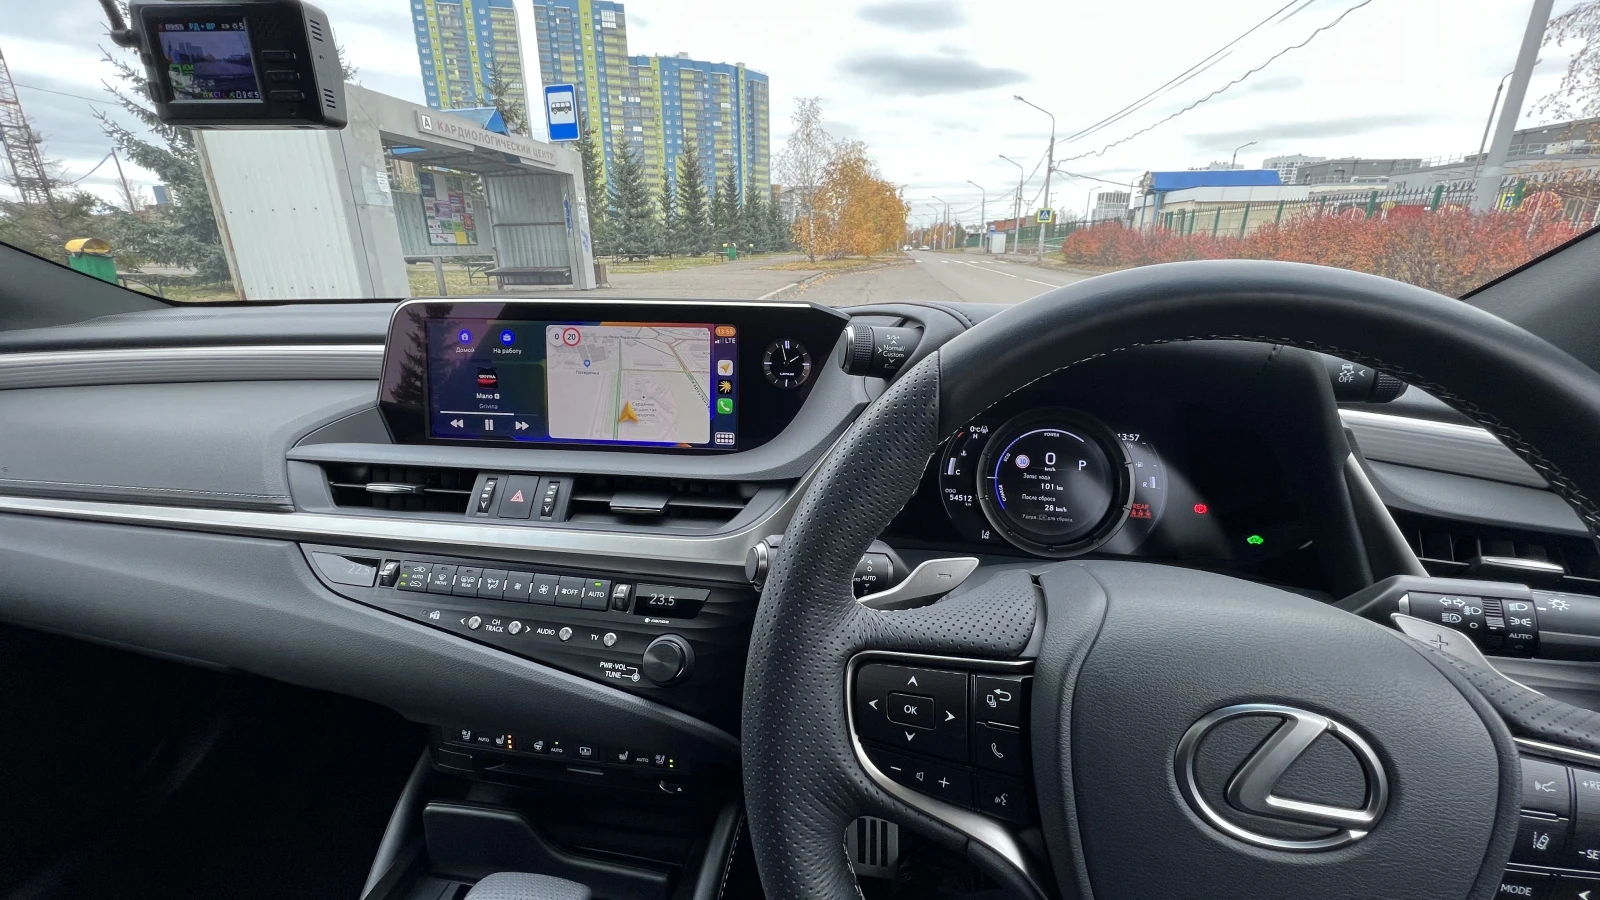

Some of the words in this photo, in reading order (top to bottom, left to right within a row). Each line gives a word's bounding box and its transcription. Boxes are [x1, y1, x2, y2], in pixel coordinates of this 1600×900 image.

[437, 120, 532, 155] КАРДИОЛОГИЧЕСКИЙ
[532, 147, 554, 161] ЦЕНТР
[567, 333, 577, 341] 20
[502, 347, 522, 355] работу
[882, 350, 905, 358] Custom
[1338, 375, 1354, 383] OFF
[1116, 432, 1140, 442] 13:57
[1045, 451, 1056, 466] 0
[1078, 459, 1087, 471] P
[1023, 472, 1038, 480] Запас
[1041, 482, 1055, 491] 101
[949, 493, 973, 502] 54512
[1021, 493, 1038, 501] После
[1038, 494, 1056, 502] сброса
[1044, 504, 1054, 512] 28
[347, 564, 371, 576] 22.5
[566, 588, 579, 596] OFF
[587, 590, 605, 598] AUTO
[649, 592, 676, 606] 23.5
[491, 618, 501, 626] CH
[485, 625, 504, 633] TRACK
[536, 627, 556, 636] AUDIO
[1508, 632, 1533, 640] AUTO
[605, 670, 622, 679] TUNE
[903, 704, 918, 716] OK
[1500, 883, 1532, 897] MODE
